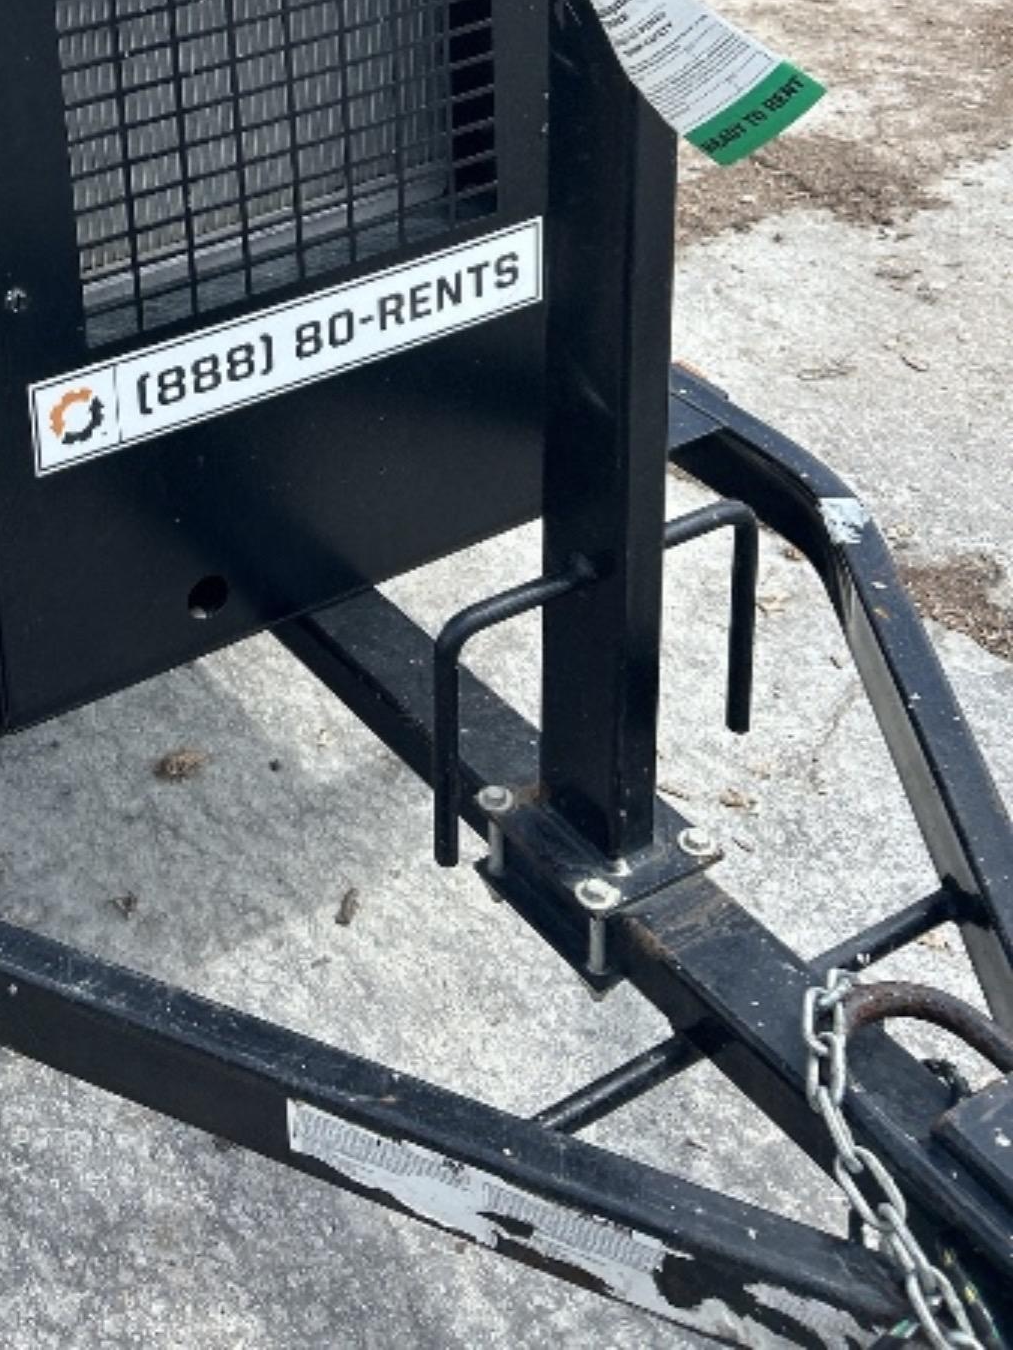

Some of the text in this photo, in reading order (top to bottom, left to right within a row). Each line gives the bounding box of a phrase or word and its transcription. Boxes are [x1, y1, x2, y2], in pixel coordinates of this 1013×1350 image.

[742, 108, 768, 128] TO
[763, 74, 805, 113] RENT
[135, 251, 520, 415] (888) 80-RENTS
